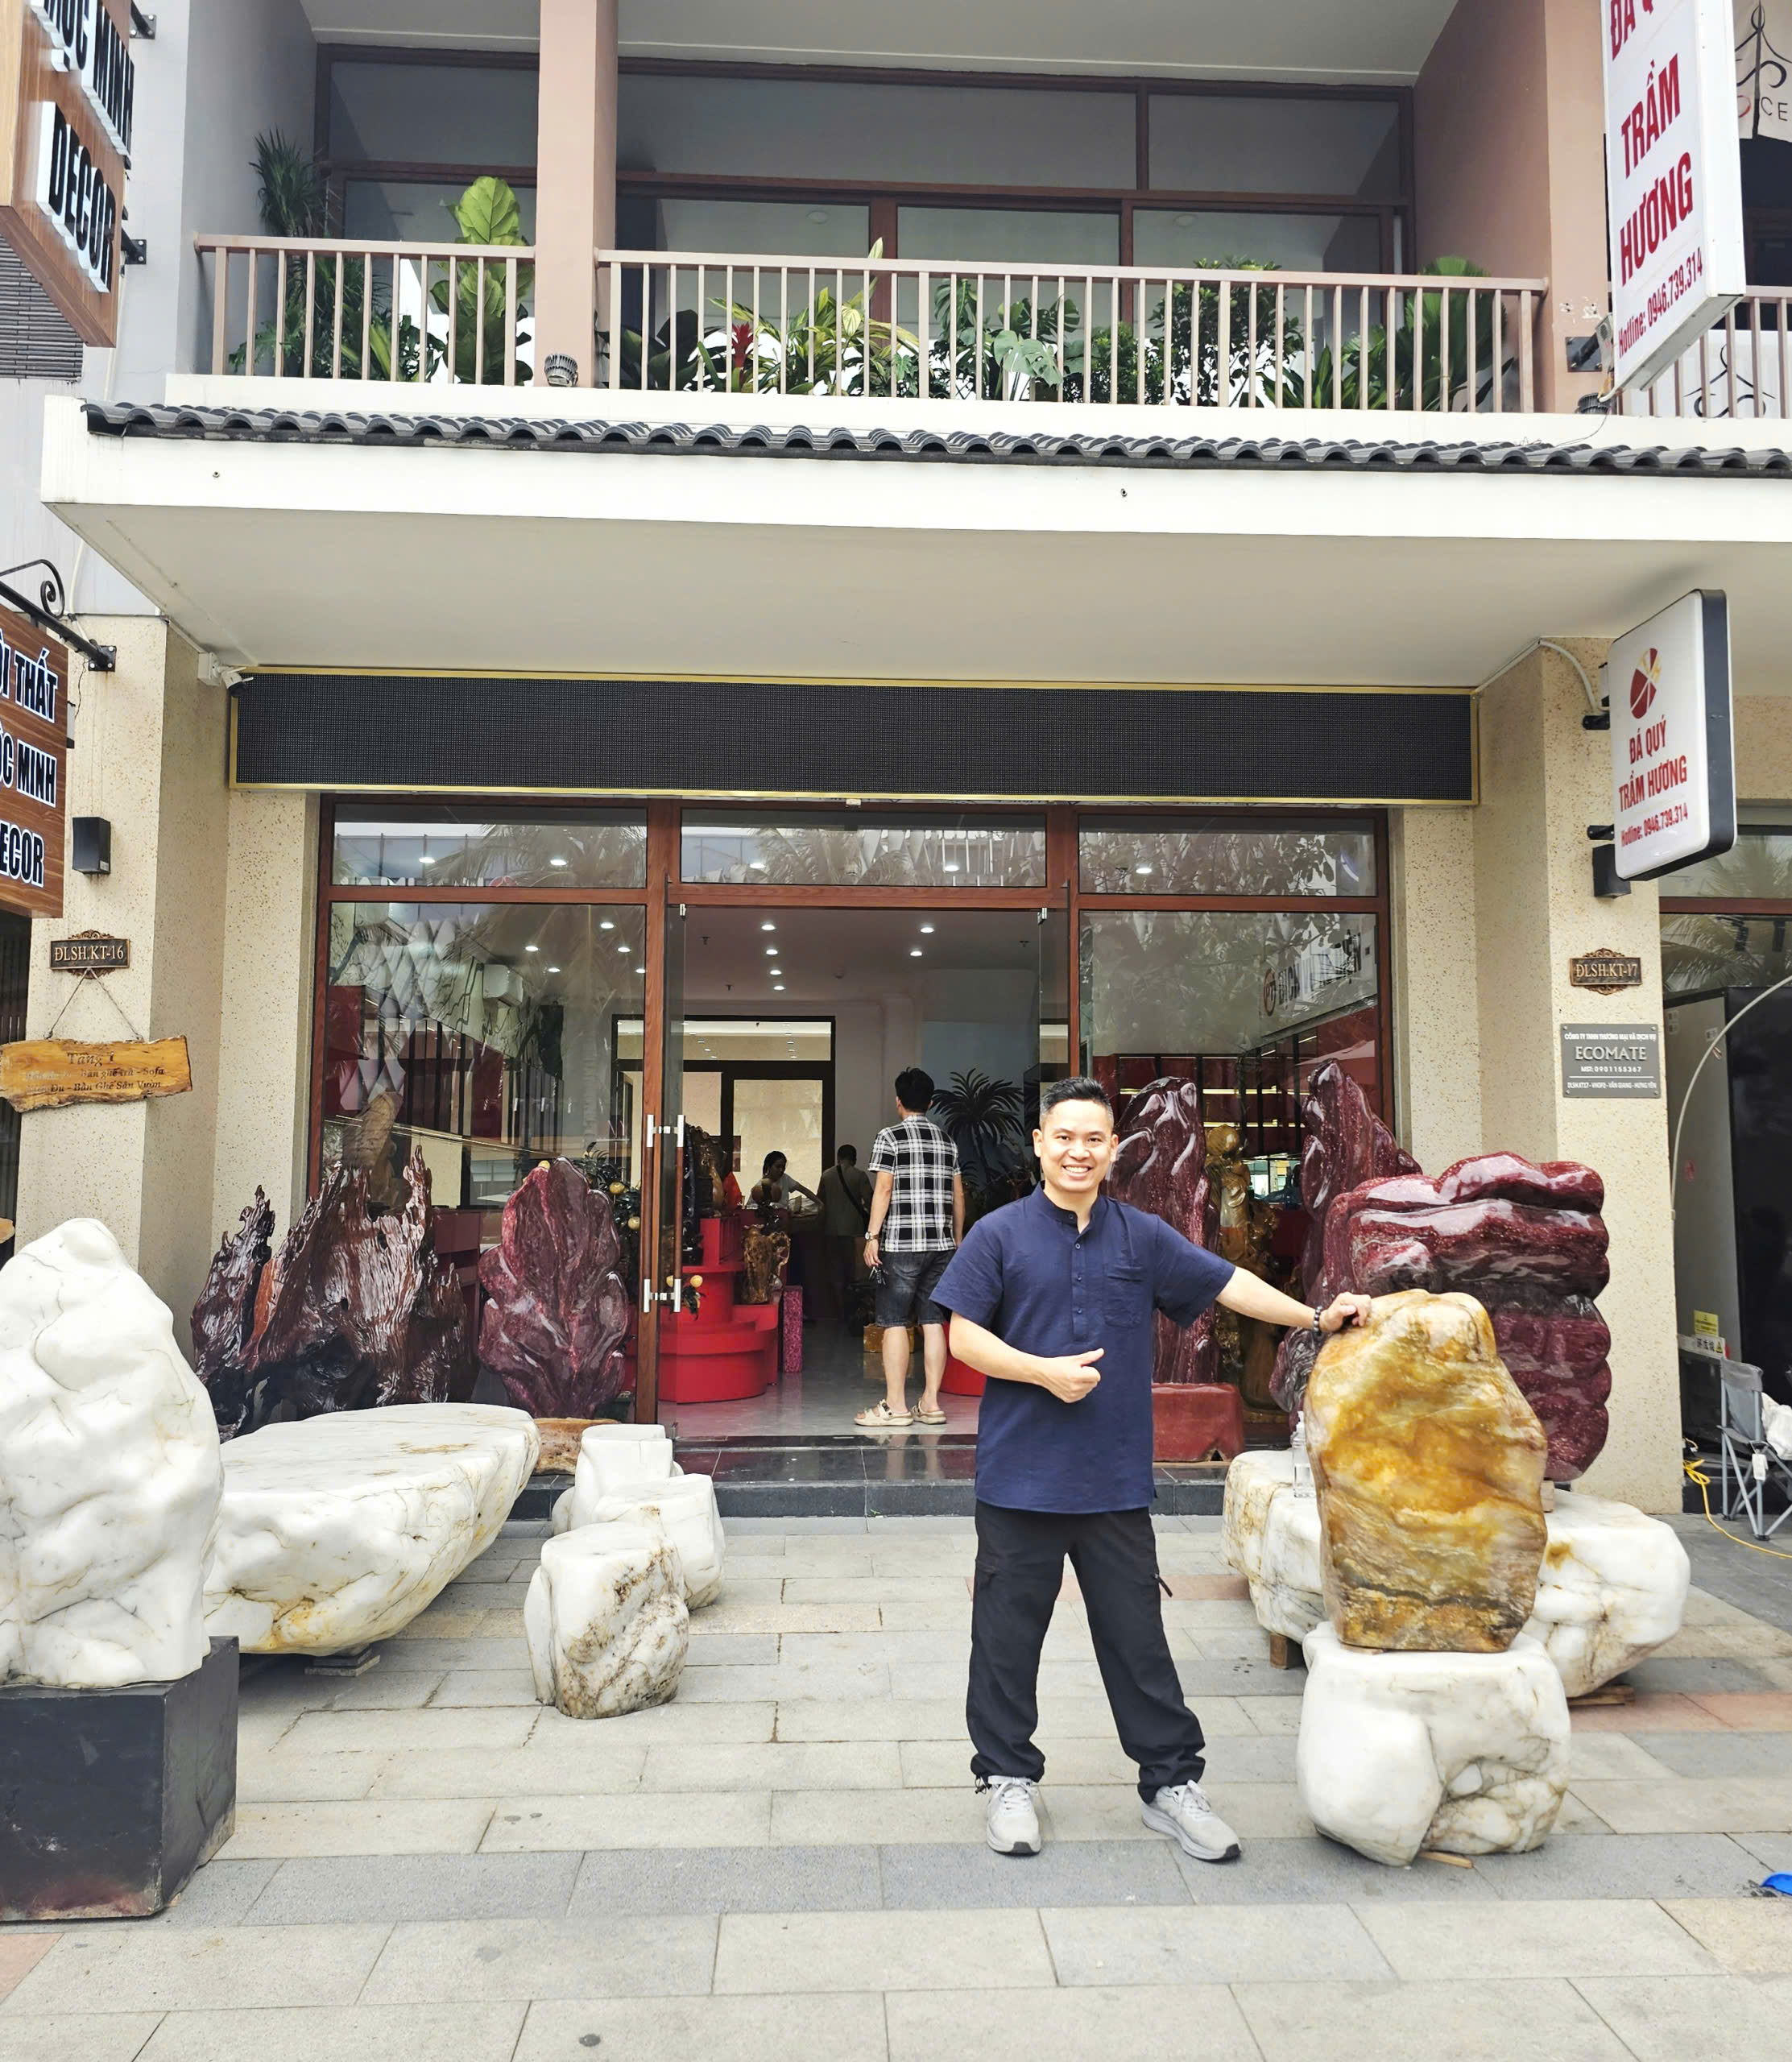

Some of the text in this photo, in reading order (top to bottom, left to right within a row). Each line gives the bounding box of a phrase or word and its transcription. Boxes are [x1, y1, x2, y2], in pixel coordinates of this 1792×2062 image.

[1621, 53, 1680, 179] TRẦM
[40, 101, 116, 293] DECOR
[1620, 152, 1693, 287] HƯƠNG
[1619, 246, 1703, 358] Hotline: 0946.739.314
[14, 647, 58, 723] THẤT
[17, 739, 57, 808] MINH
[1629, 714, 1666, 764] ĐÁ QUÝ
[1619, 755, 1687, 812] TRẦM HƯƠNG
[55, 945, 124, 961] ĐLSH.KT-16
[1576, 963, 1637, 977] ĐLSH.KT-17
[1575, 1046, 1646, 1060] ECOMATE
